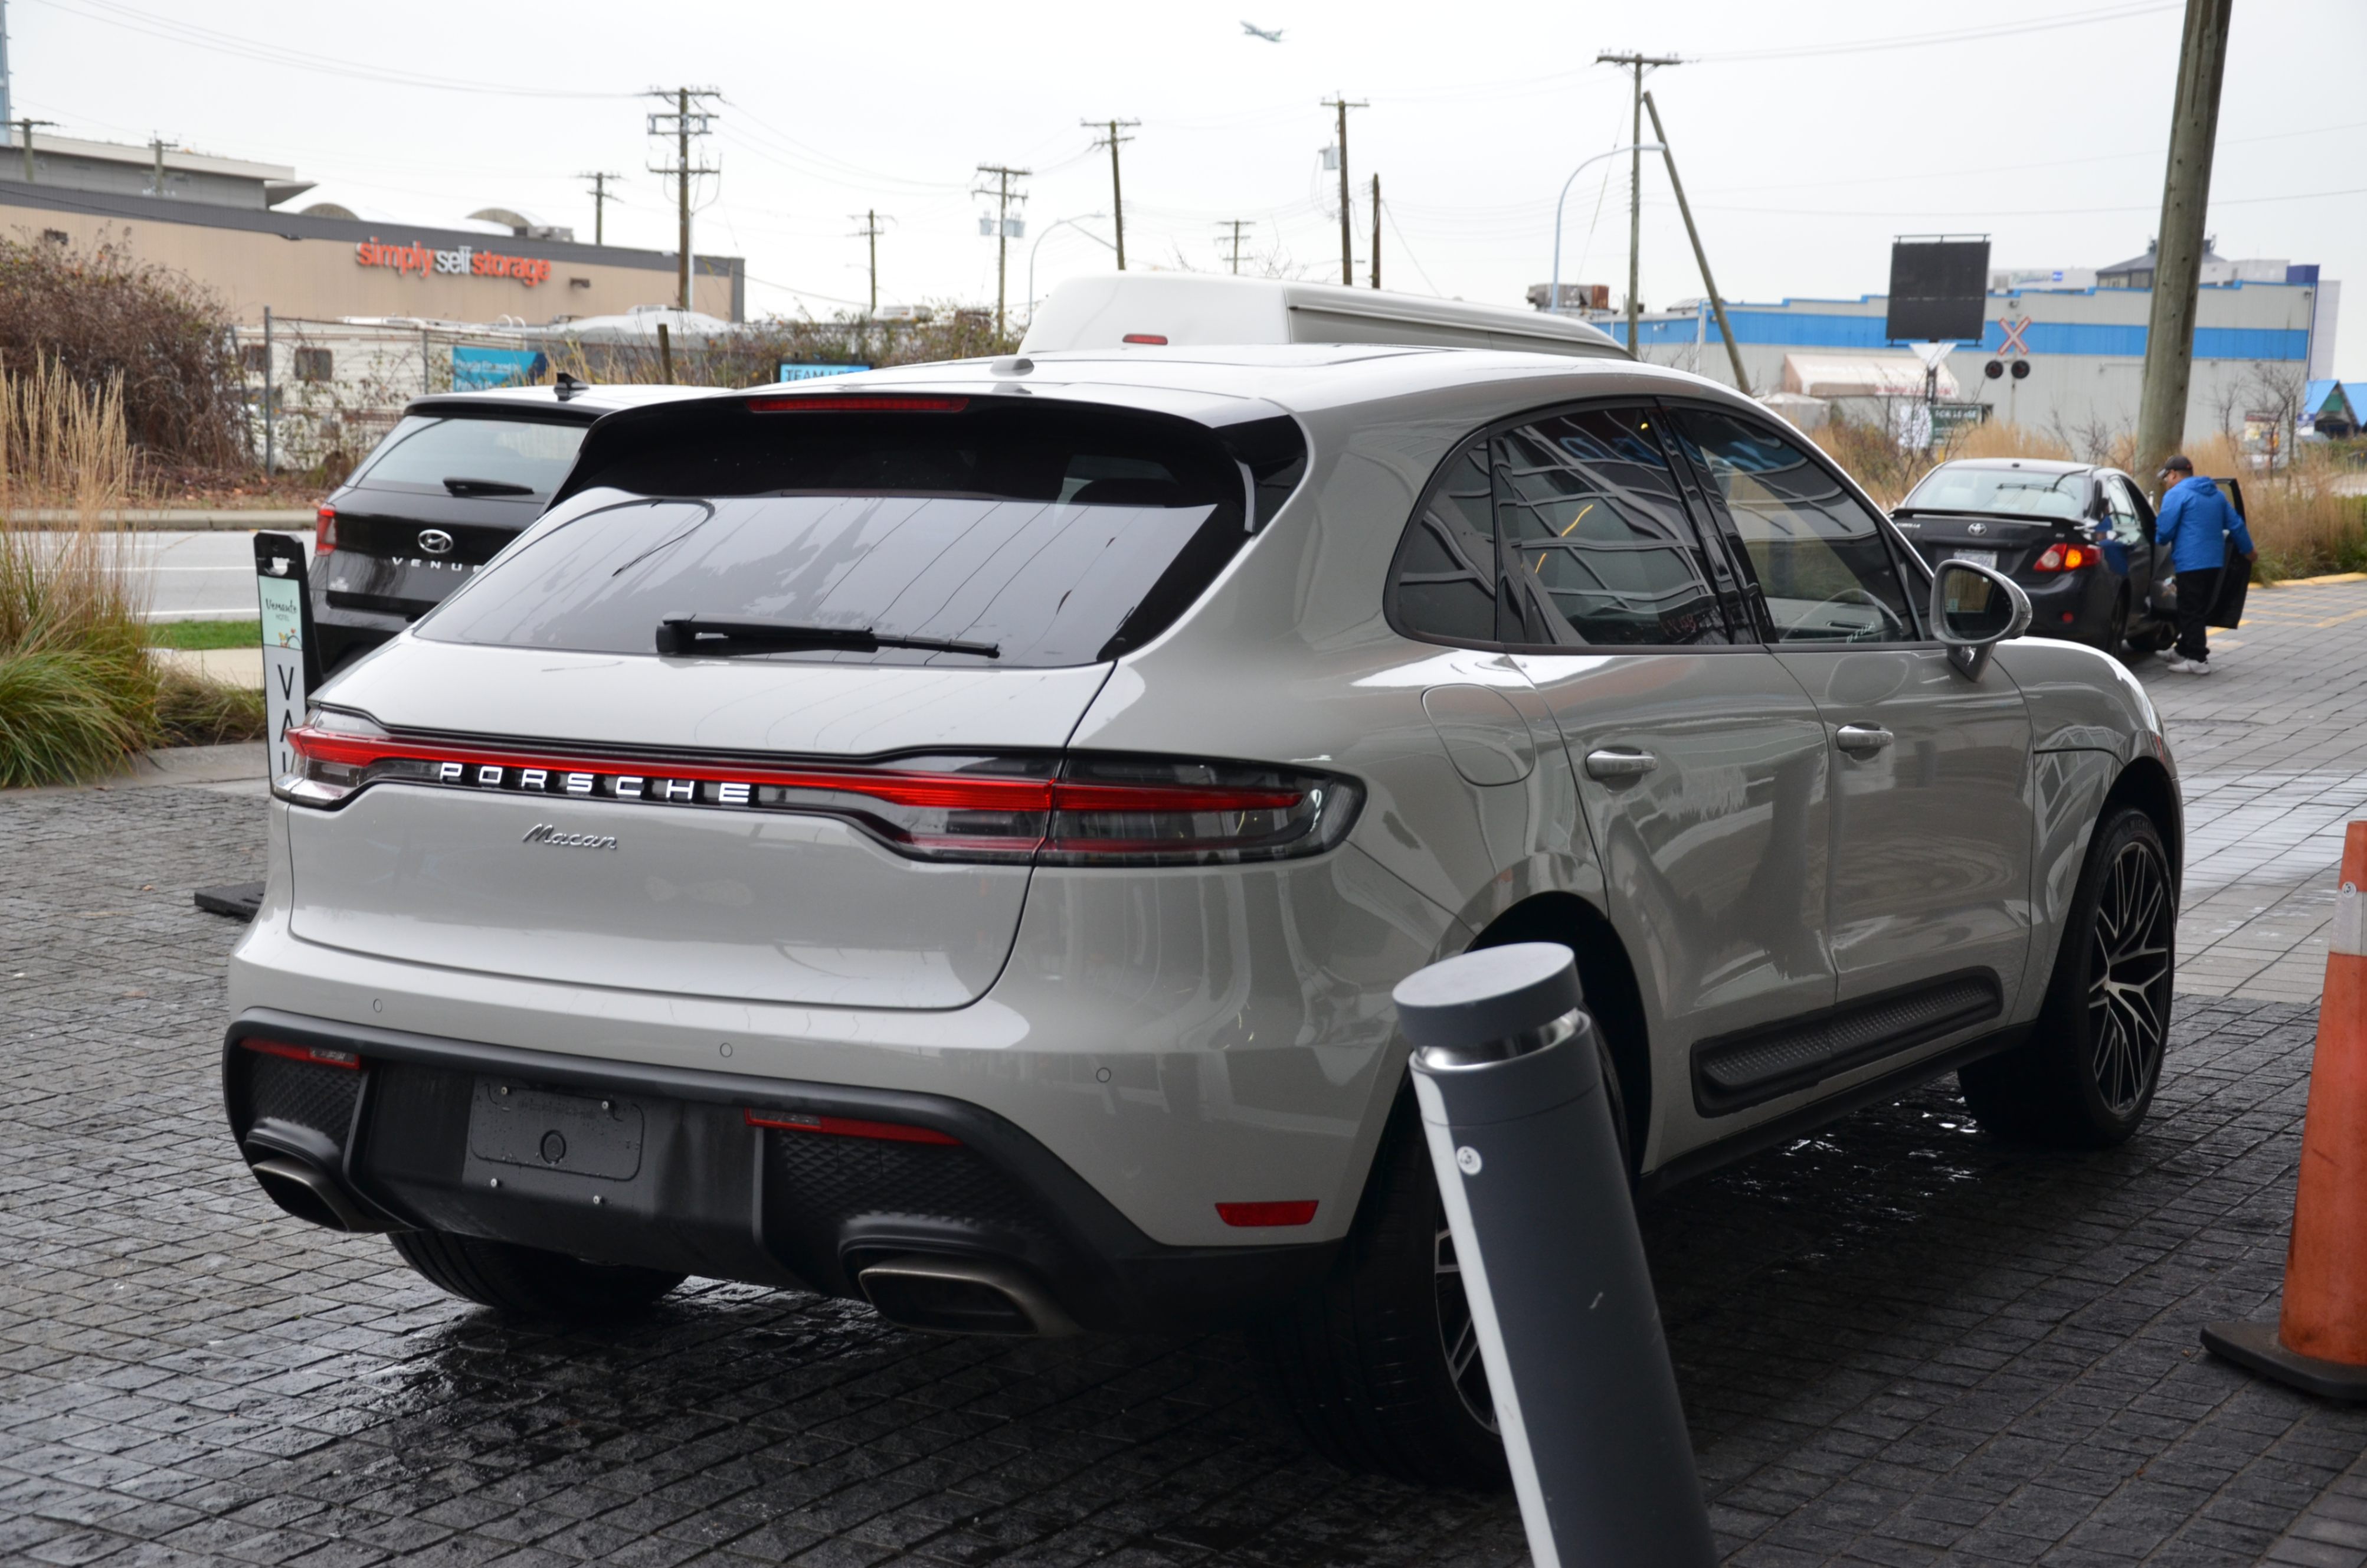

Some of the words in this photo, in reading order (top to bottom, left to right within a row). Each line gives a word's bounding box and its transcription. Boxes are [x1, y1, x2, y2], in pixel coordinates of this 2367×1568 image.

[356, 237, 434, 277] simply
[436, 245, 473, 274] self
[473, 251, 551, 286] storage
[276, 614, 290, 622] HOTEL
[440, 762, 751, 803] PORSCHE
[522, 823, 617, 850] Macan
